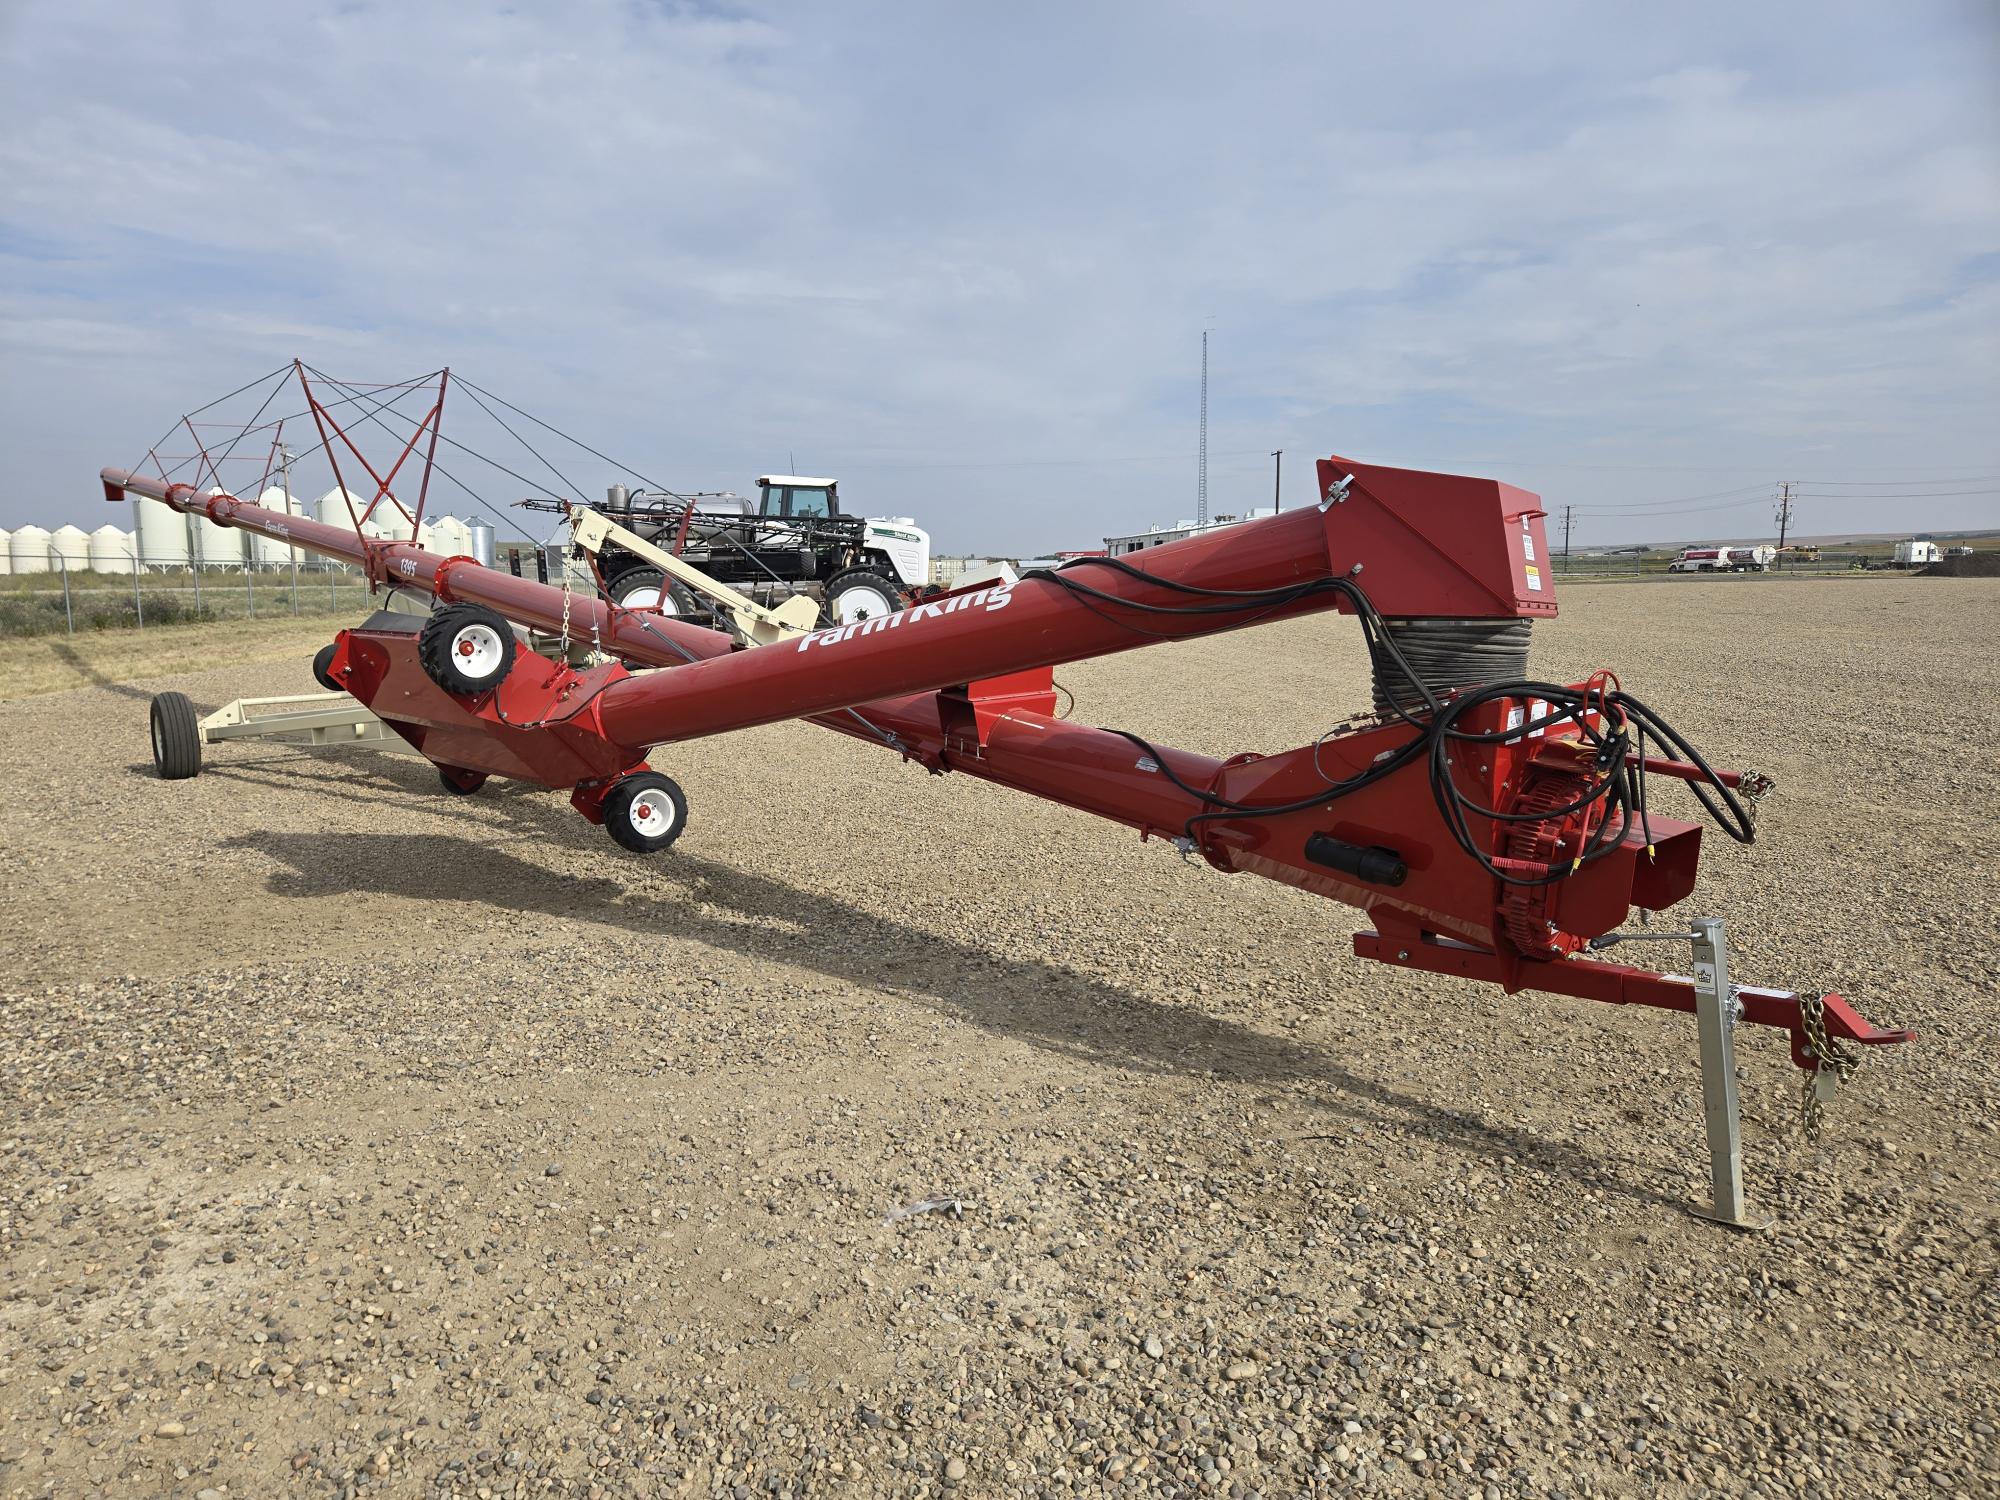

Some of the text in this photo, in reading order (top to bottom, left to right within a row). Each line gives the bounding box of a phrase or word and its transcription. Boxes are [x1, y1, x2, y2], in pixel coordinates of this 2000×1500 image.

[400, 558, 418, 577] 1395
[797, 581, 1020, 653] Farm King
